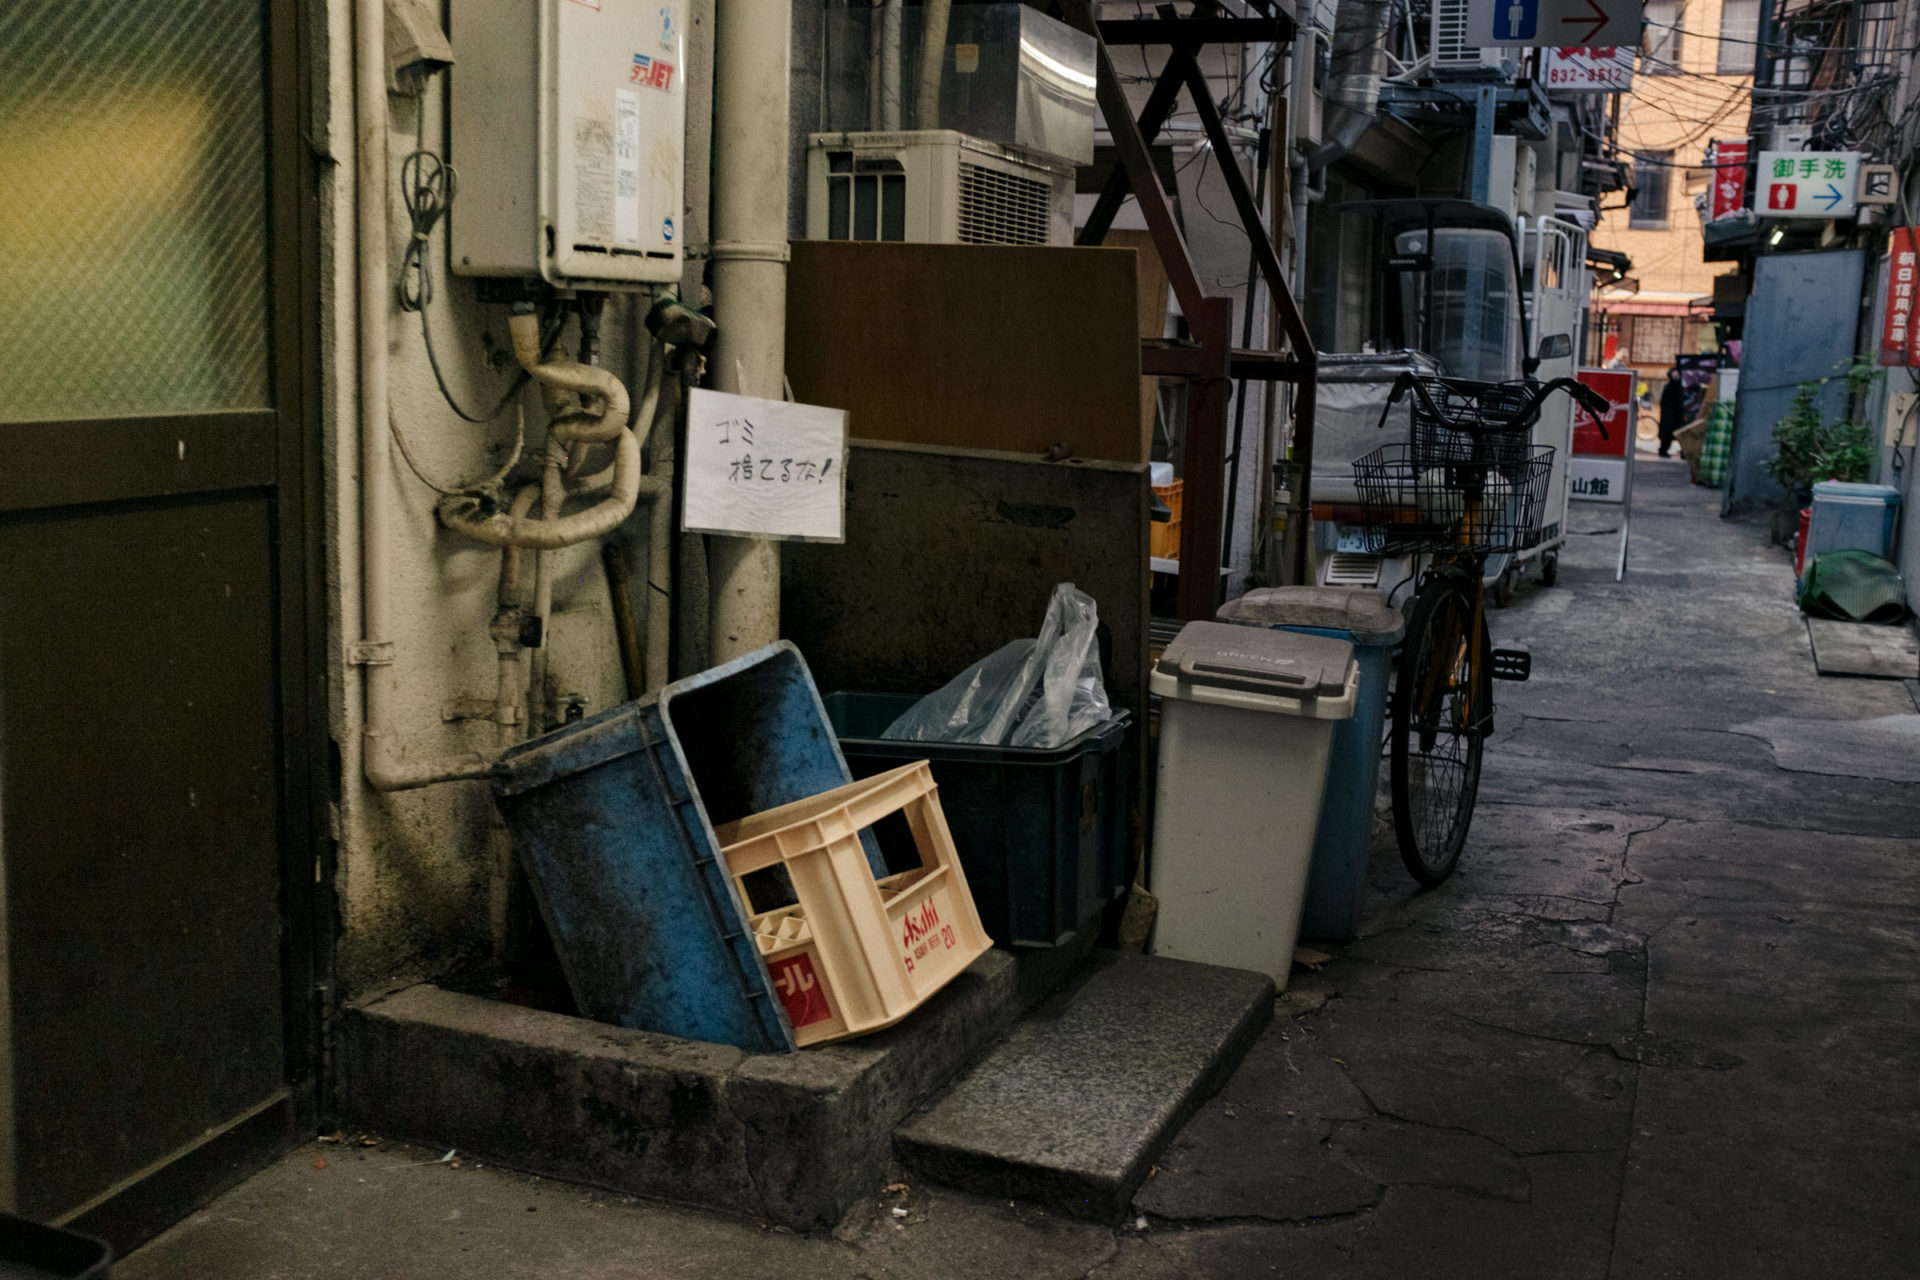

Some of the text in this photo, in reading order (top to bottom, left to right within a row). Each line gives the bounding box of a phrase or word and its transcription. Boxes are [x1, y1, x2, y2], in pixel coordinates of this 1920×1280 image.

[1773, 158, 1847, 179] 御手洗
[1891, 252, 1915, 342] 朝日信用金庫
[716, 419, 754, 445] ゴミ
[904, 896, 939, 949] Asahi
[941, 924, 955, 949] 20
